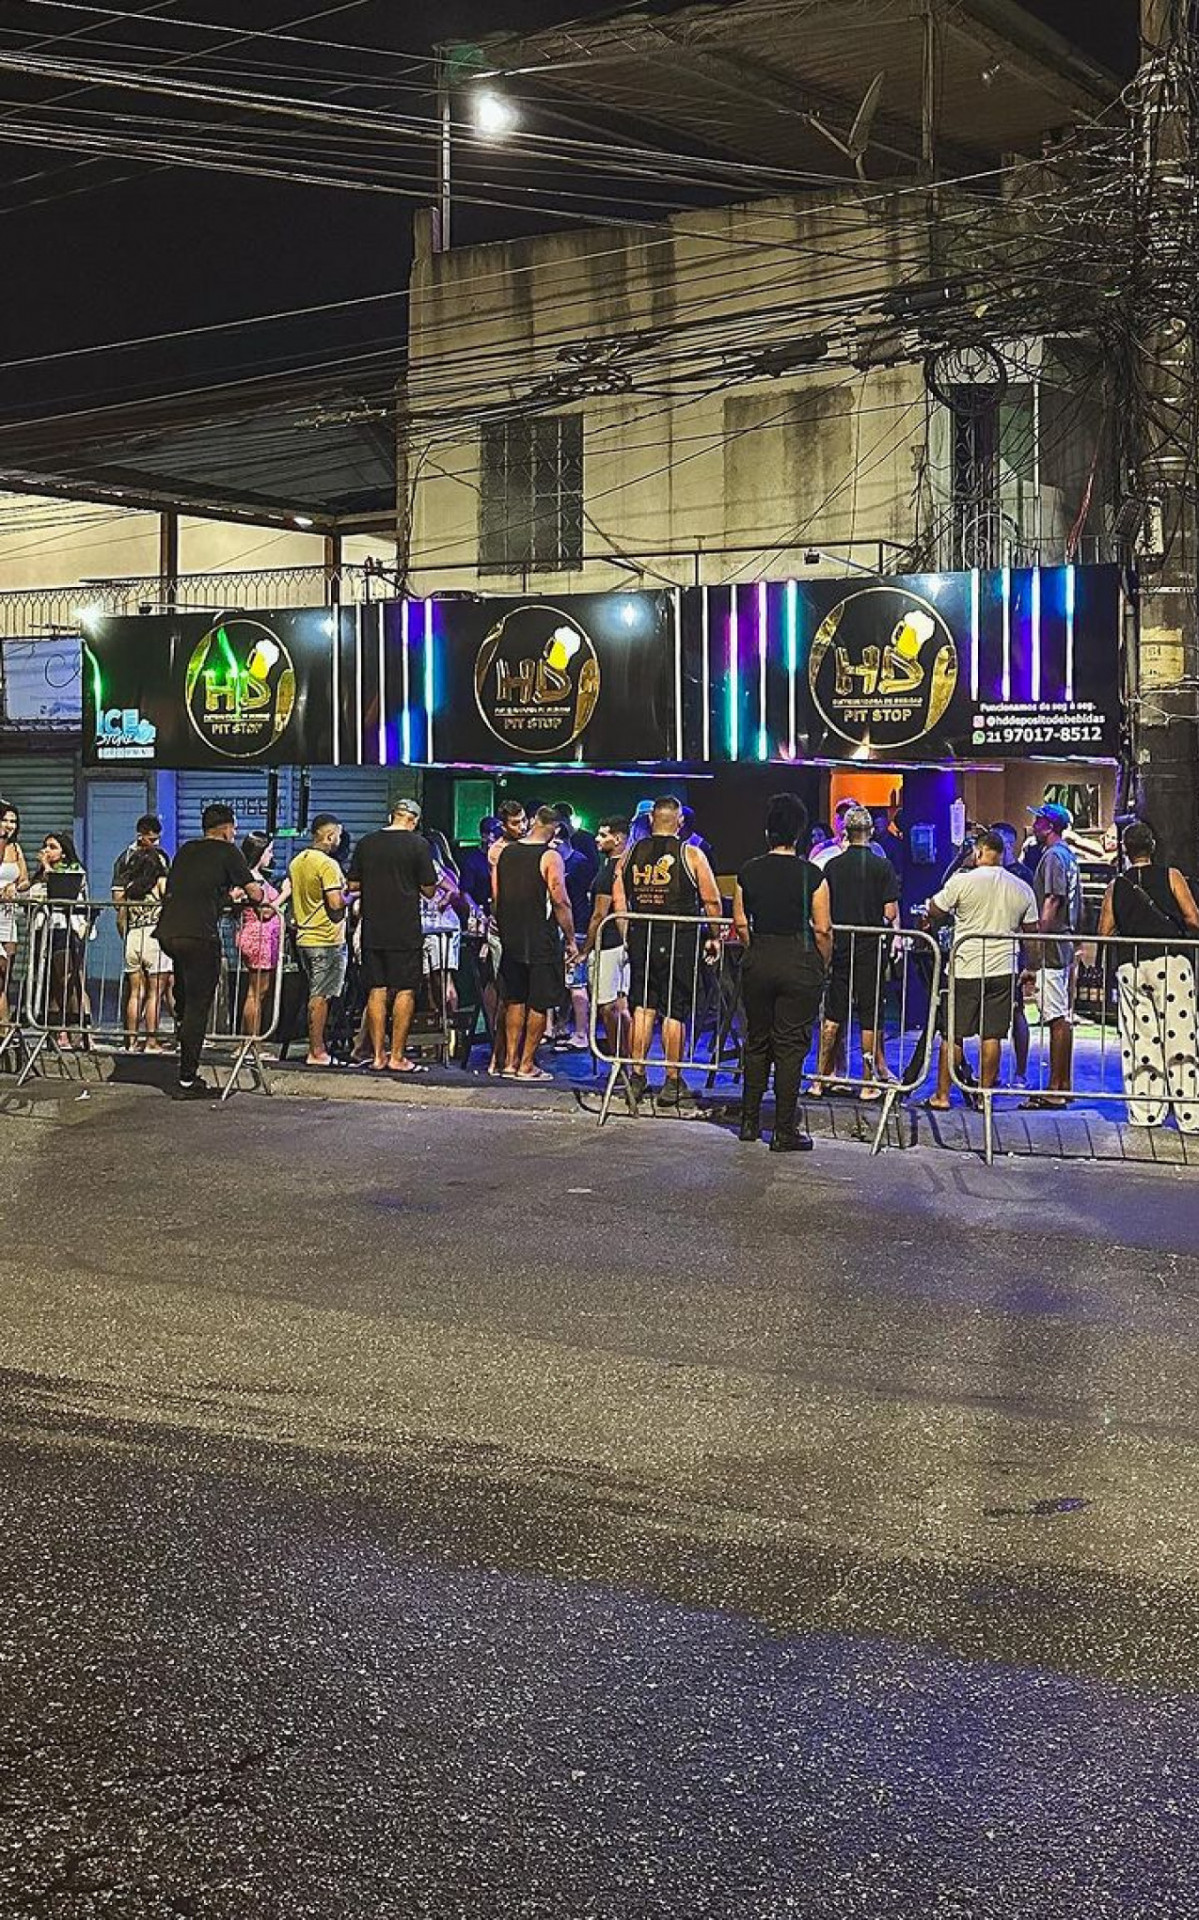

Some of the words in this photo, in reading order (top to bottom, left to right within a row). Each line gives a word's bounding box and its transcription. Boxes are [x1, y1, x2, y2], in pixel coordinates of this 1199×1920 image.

[96, 708, 140, 736] ICE
[843, 709, 868, 722] PIT
[872, 708, 912, 721] STOP
[986, 713, 1106, 727] @hddepositodebebidas
[986, 731, 1002, 743] 21
[1003, 726, 1103, 743] 97017-8512
